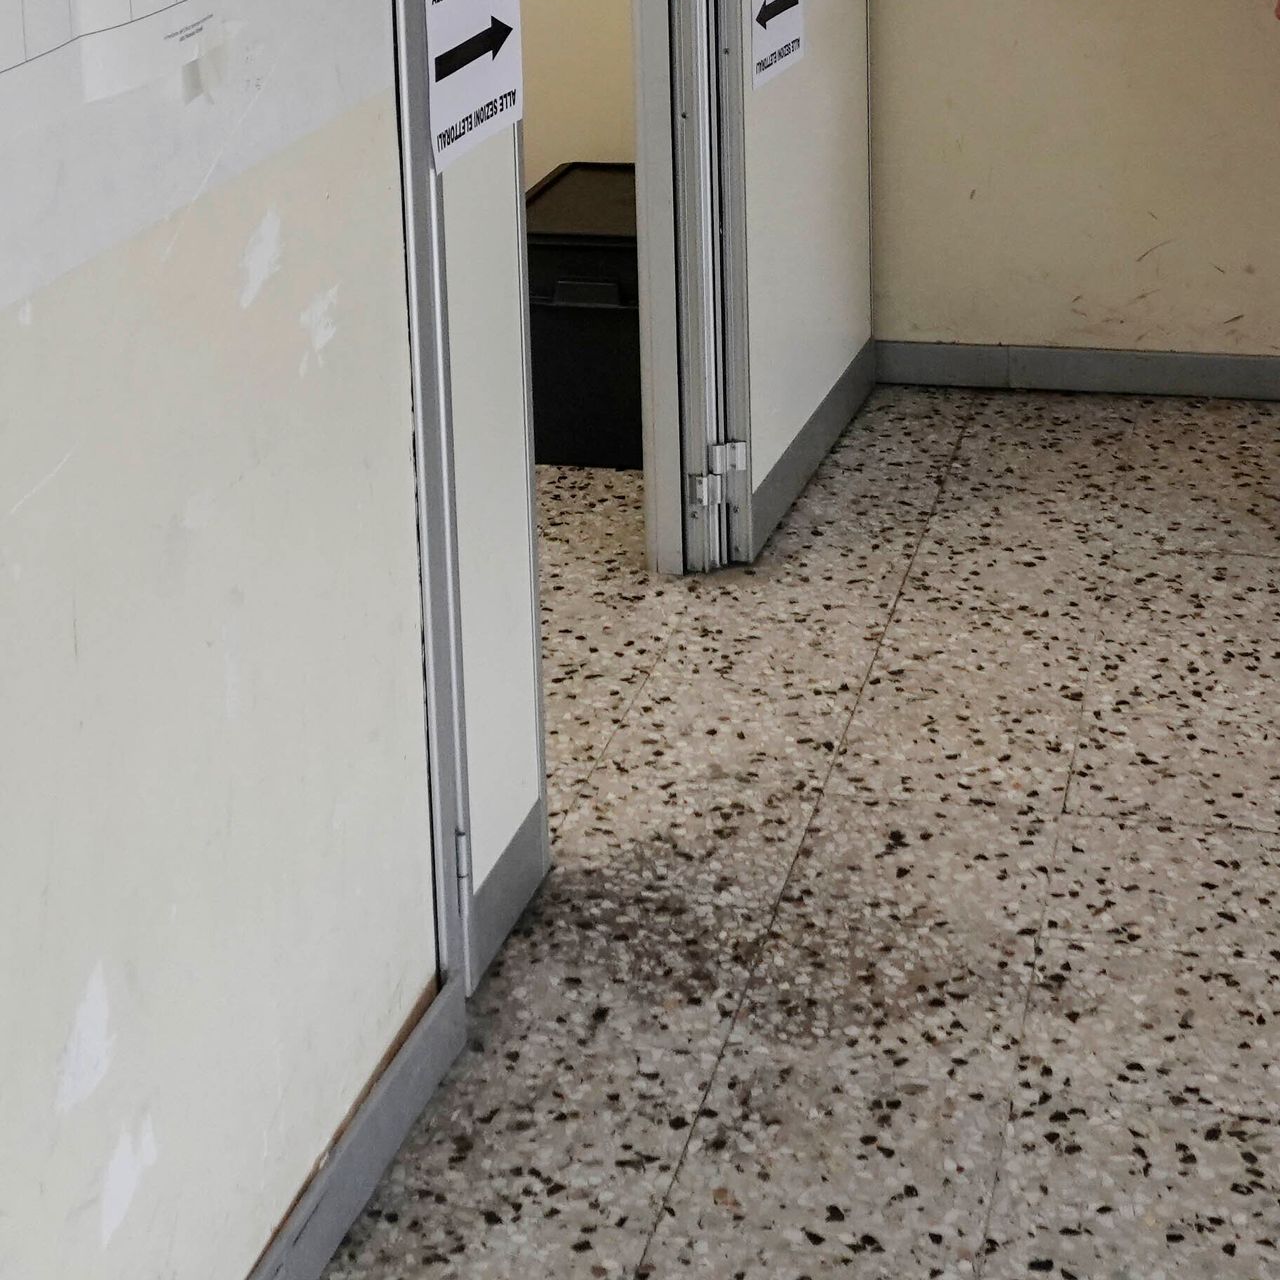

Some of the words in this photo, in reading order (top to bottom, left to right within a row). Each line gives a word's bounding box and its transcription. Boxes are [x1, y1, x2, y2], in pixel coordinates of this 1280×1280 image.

[474, 96, 498, 129] SEZIONI
[499, 88, 517, 113] ALLE
[437, 114, 472, 153] ELETTORALI
